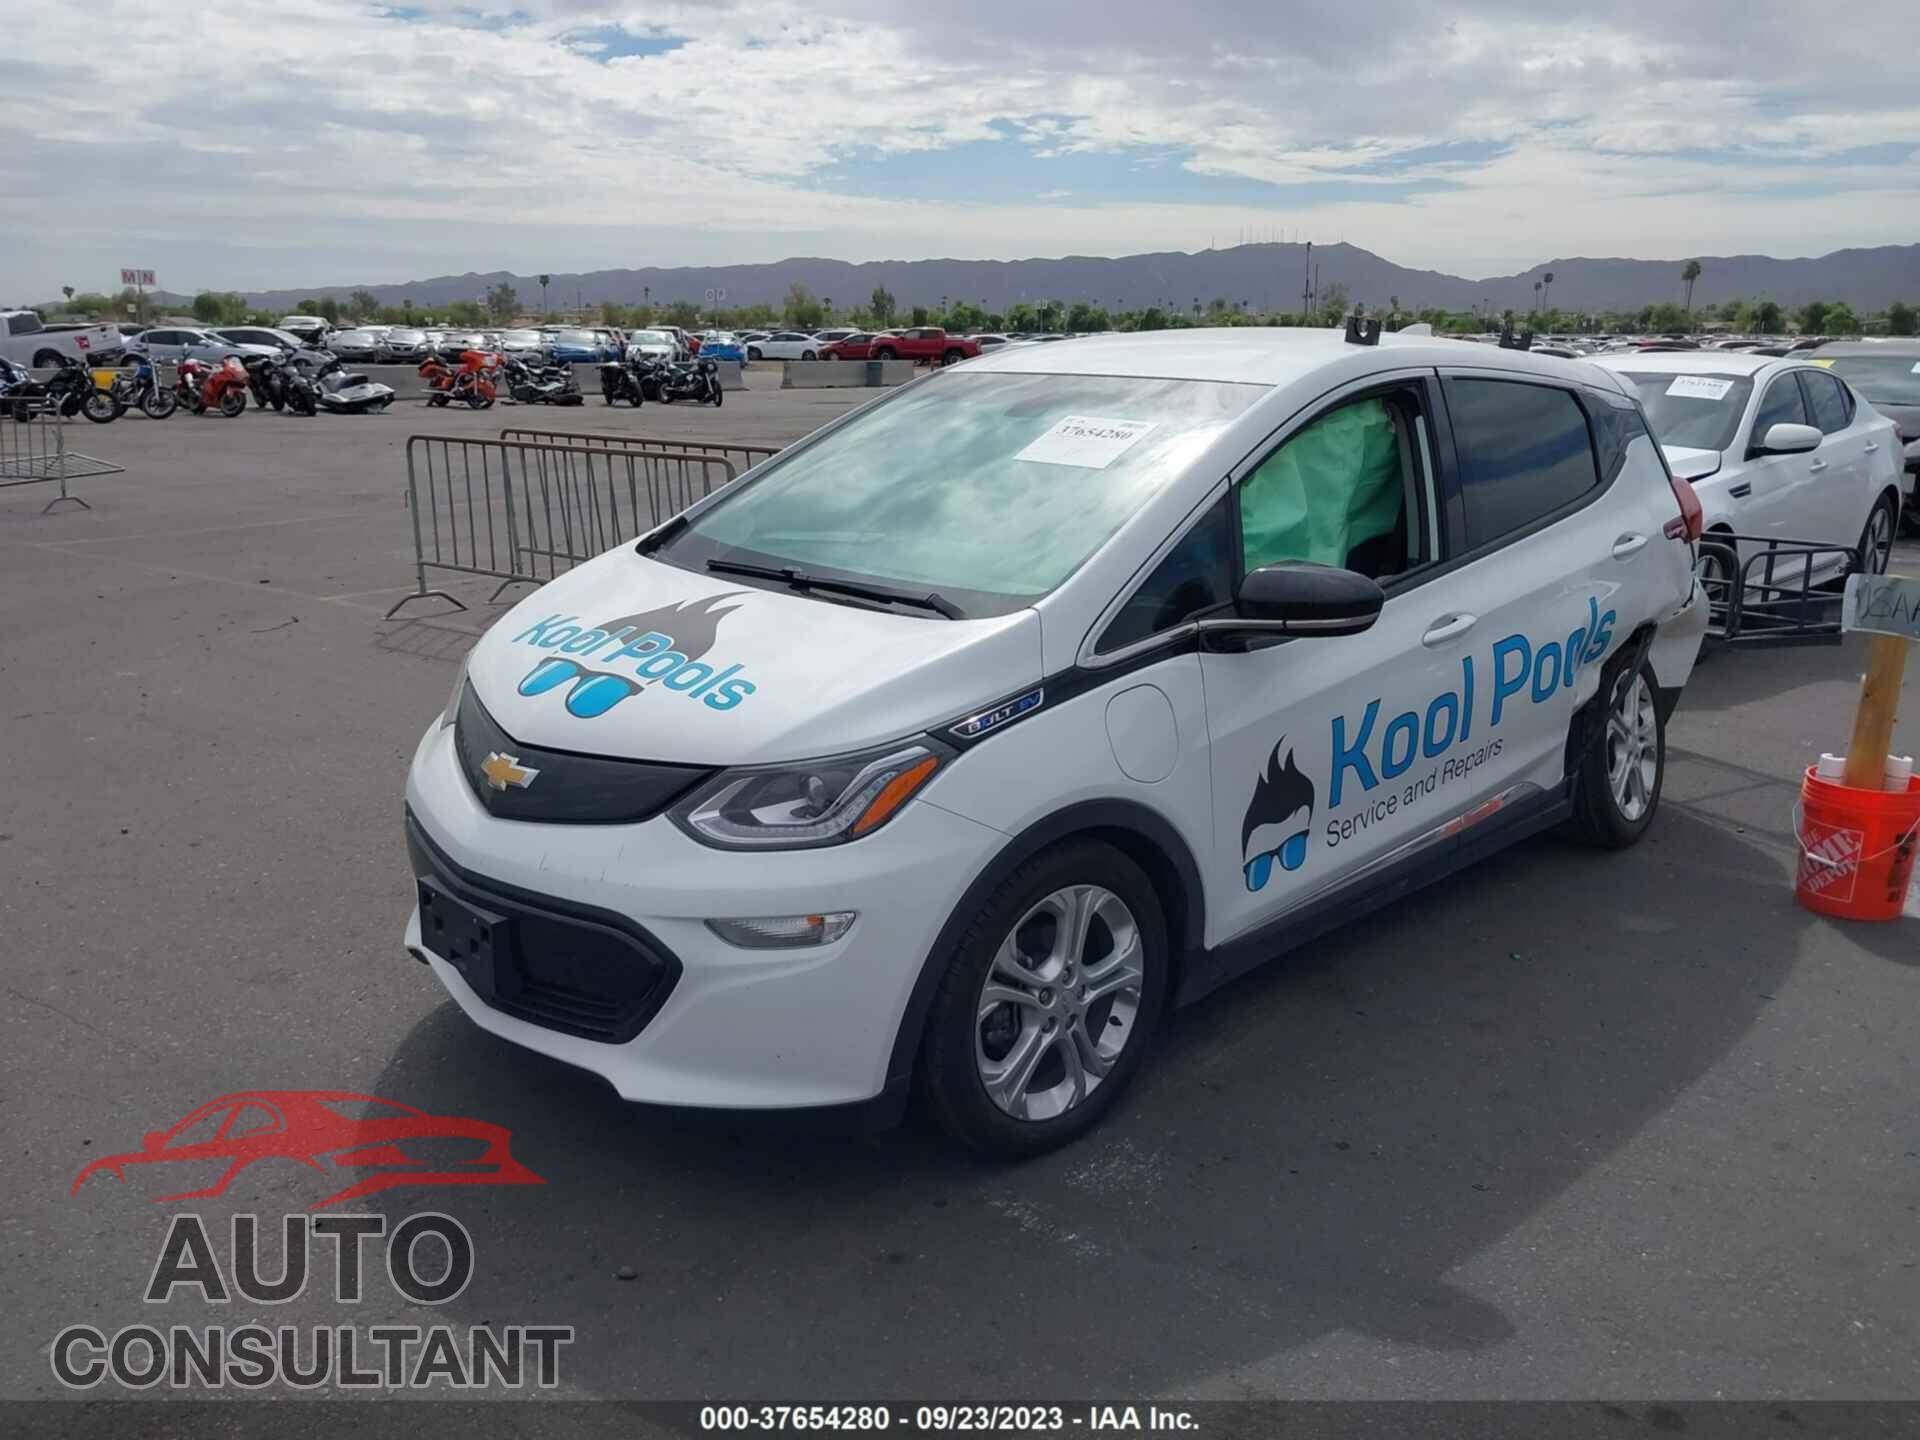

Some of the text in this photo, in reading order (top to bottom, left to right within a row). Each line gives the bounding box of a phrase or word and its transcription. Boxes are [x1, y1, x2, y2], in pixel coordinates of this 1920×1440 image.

[512, 614, 757, 711] Kool Pools
[1328, 655, 1475, 811] Kool
[1327, 738, 1504, 847] Service and Repairs
